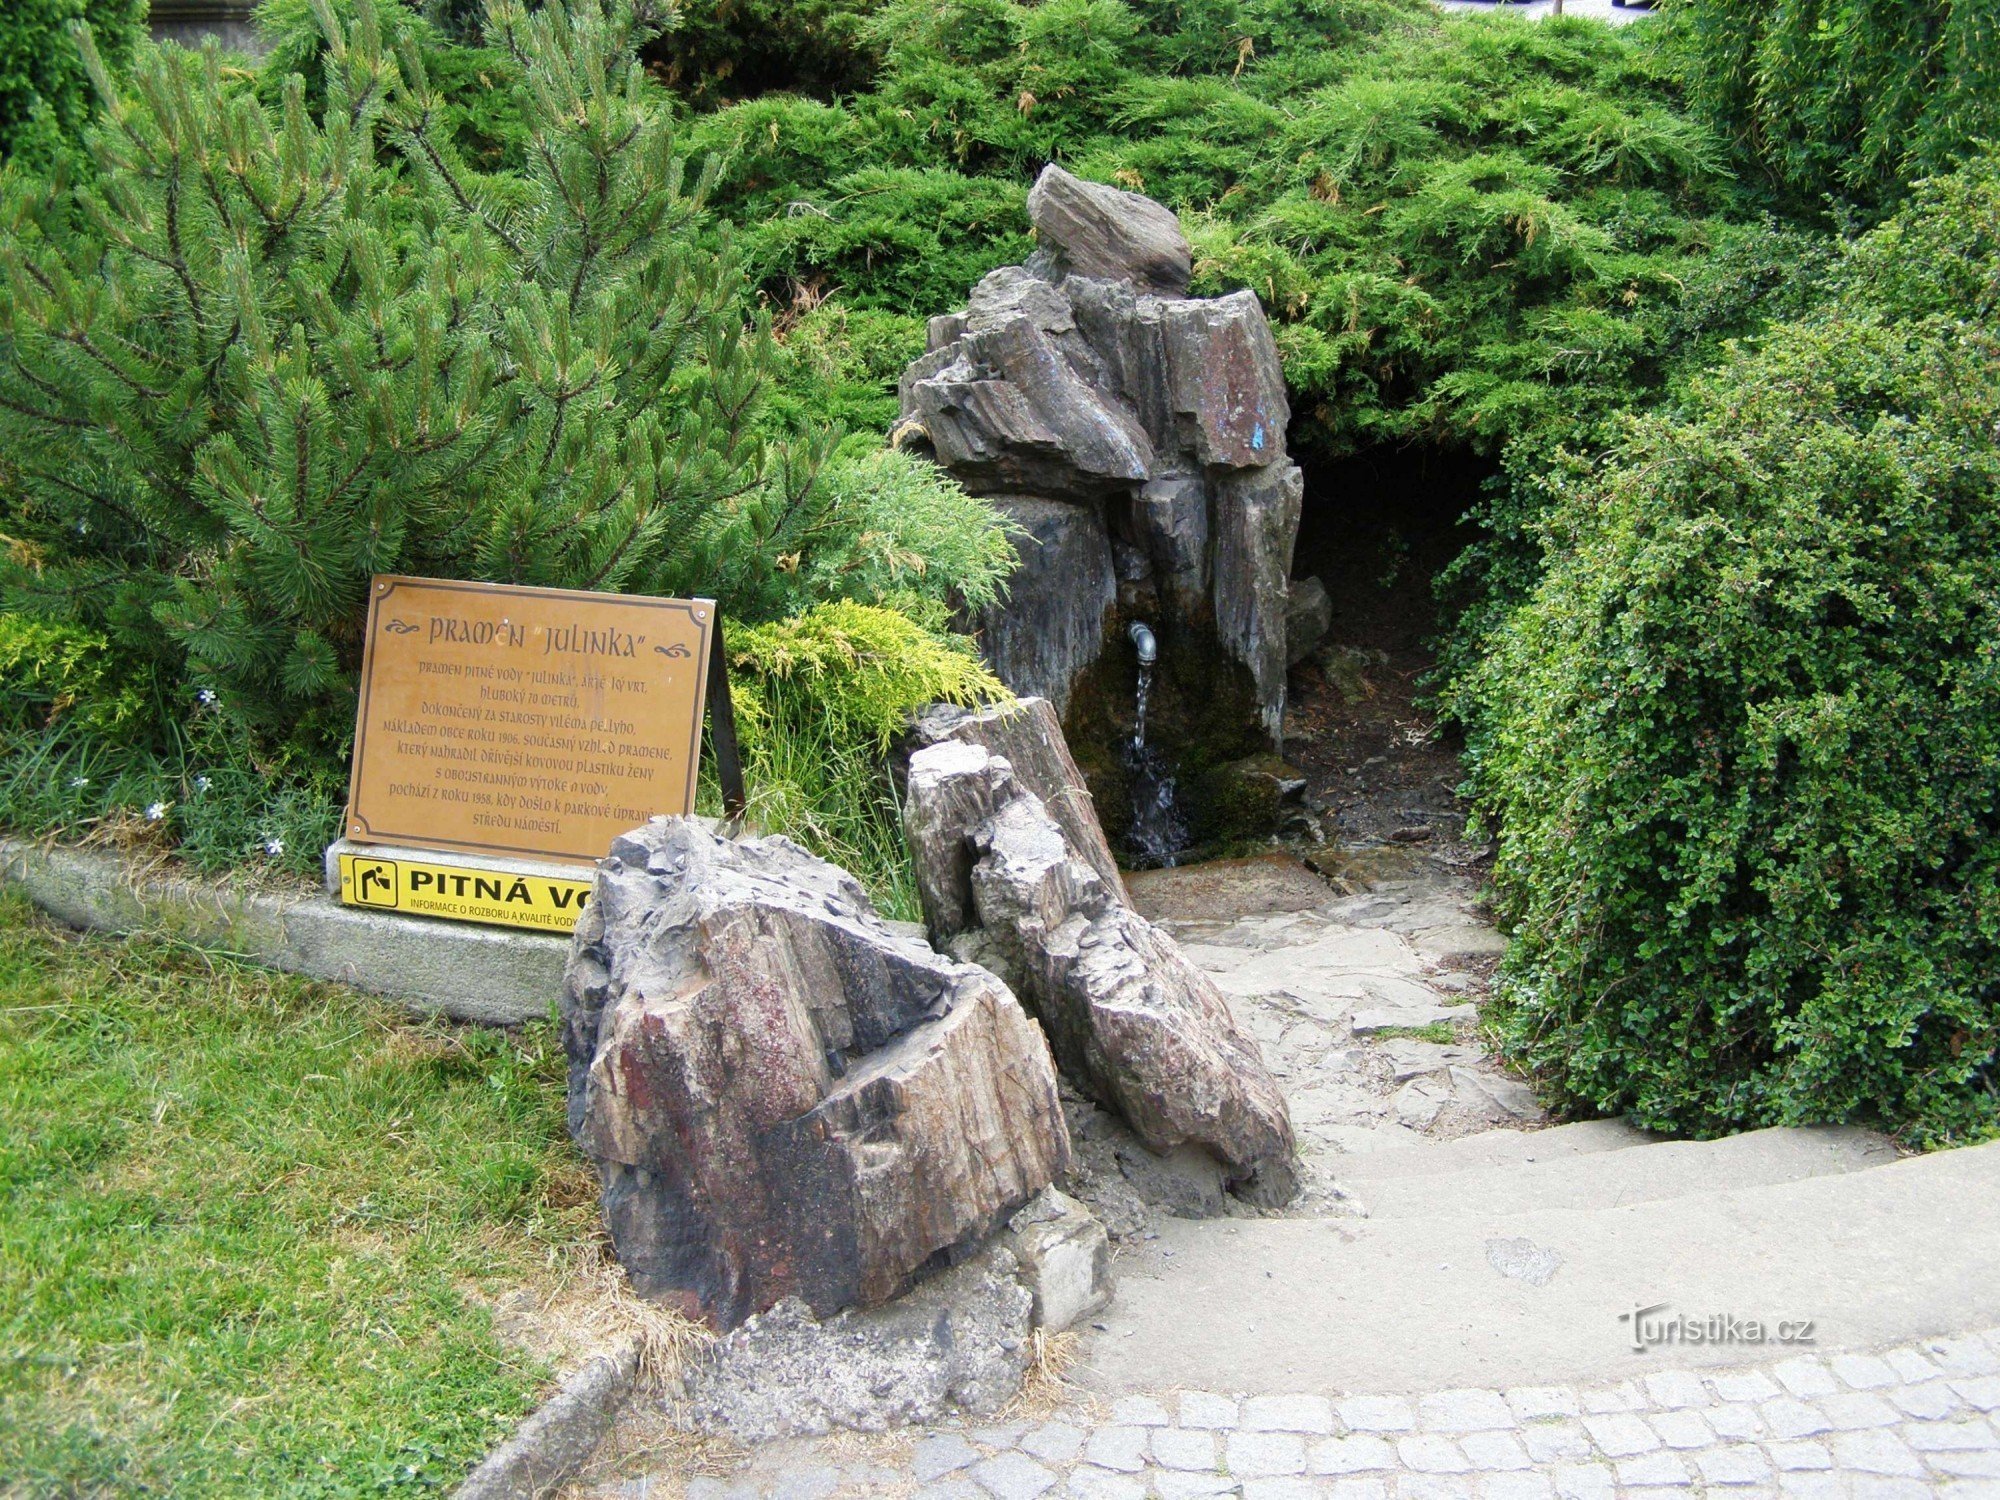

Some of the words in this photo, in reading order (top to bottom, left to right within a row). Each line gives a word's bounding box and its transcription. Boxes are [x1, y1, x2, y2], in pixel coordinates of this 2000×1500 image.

[429, 617, 525, 647] PRAMEN
[419, 661, 462, 675] PRAMEN
[465, 664, 494, 679] PITNÉ
[497, 668, 523, 683] VODY
[581, 672, 625, 693] ARTÉKÝ
[627, 681, 648, 694] VRT,
[480, 685, 526, 703] HLUBOKÝ
[528, 693, 538, 704] 70
[421, 701, 483, 721] DOKONČENÝ
[485, 709, 496, 722] ZA
[499, 711, 549, 726] STAROSTY
[550, 714, 587, 730] VILÉMA
[383, 719, 437, 737] NÁKLADEM
[439, 726, 465, 739] OBCE
[467, 727, 495, 742] ROKU
[499, 733, 520, 745] 1906.
[523, 734, 576, 751] SOUČASNÝ
[397, 740, 428, 758] KTERÝ
[430, 745, 477, 761] NAHRADIL
[481, 749, 523, 766] DŘÍVĚJŠÍ
[525, 753, 573, 771] KOVOVOU
[576, 760, 624, 777] PLASTIKU
[627, 764, 655, 782] ŽENY
[435, 767, 442, 778] S
[444, 769, 527, 789] OBOUSTRANNÝM
[389, 783, 431, 797] POCHÁZÍ
[432, 788, 439, 799] Z
[441, 788, 469, 802] ROKU
[472, 793, 493, 807] 1958,
[496, 792, 517, 809] KDY
[519, 795, 551, 811] DOŠLO
[554, 799, 560, 813] K
[564, 801, 611, 819] PARKOVÉ
[473, 812, 511, 829] STŘEDU
[514, 816, 562, 834] NÁMĚSTÍ.
[410, 870, 533, 905] PITNÁ
[410, 898, 458, 914] INFORMACE
[460, 905, 467, 915] O
[469, 906, 509, 920] ROZBORU
[512, 911, 518, 920] A
[519, 911, 552, 925] KVALITĚ
[554, 915, 578, 927] VODY
